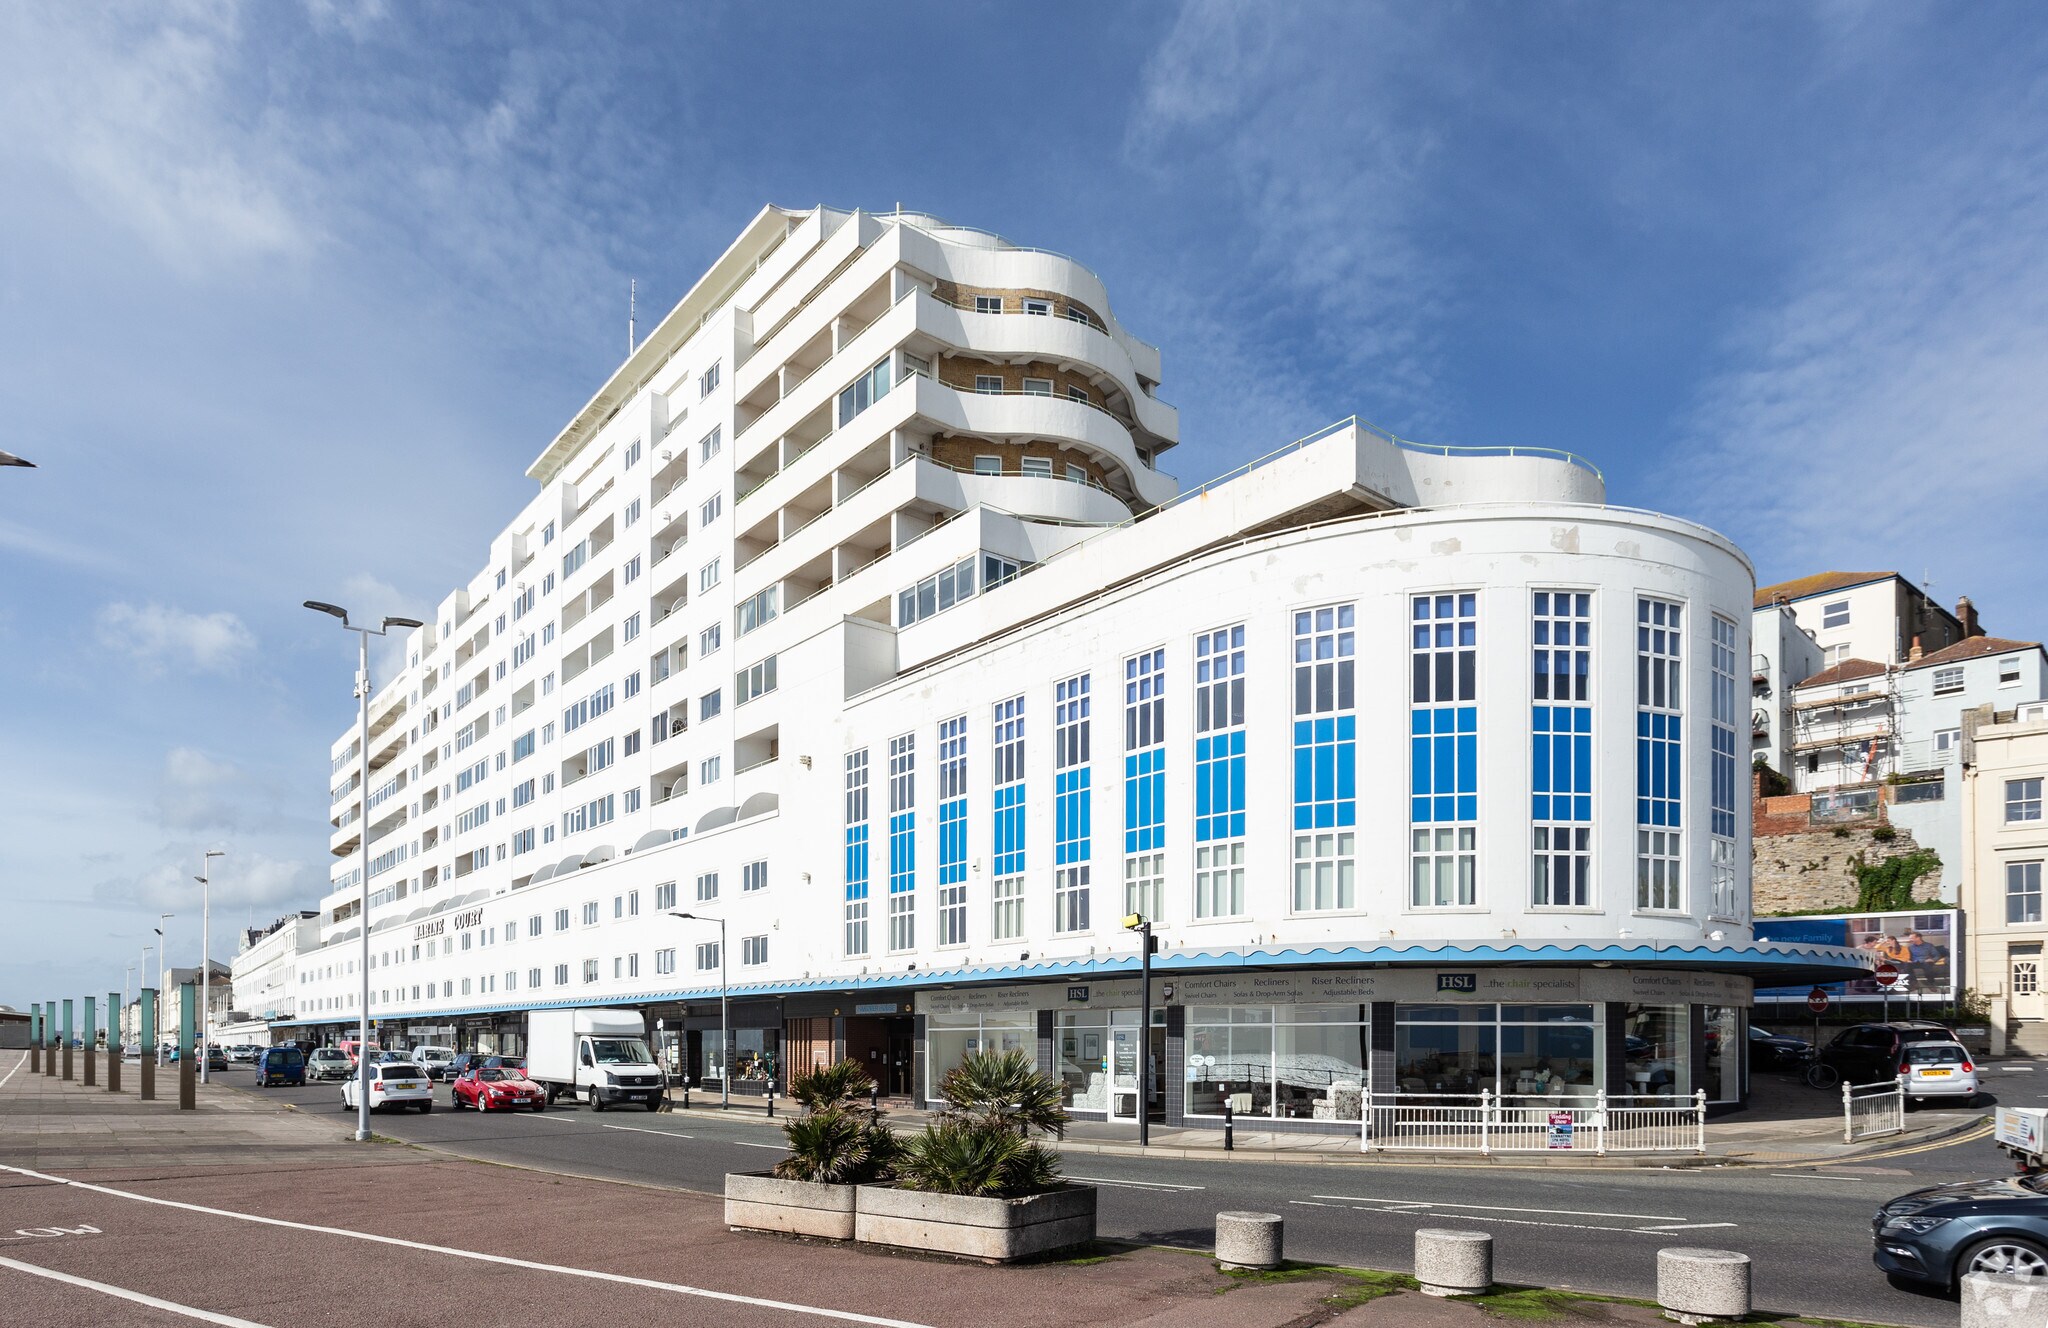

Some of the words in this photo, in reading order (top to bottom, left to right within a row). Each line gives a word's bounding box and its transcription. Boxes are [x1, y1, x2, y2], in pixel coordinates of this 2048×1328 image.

[414, 918, 444, 940] MARINE
[454, 908, 483, 930] COURT
[1803, 934, 1833, 943] Family
[1214, 980, 1236, 988] Chairs
[1254, 978, 1289, 986] Recliners
[1441, 976, 1472, 988] HSL
[1483, 979, 1504, 988] ...the
[1507, 979, 1530, 988] chair
[1533, 979, 1575, 990] specialists
[1633, 976, 1660, 984] Comfort
[1662, 977, 1681, 985] Chairs
[1694, 978, 1714, 987] Recliners
[1070, 988, 1087, 998] HSL
